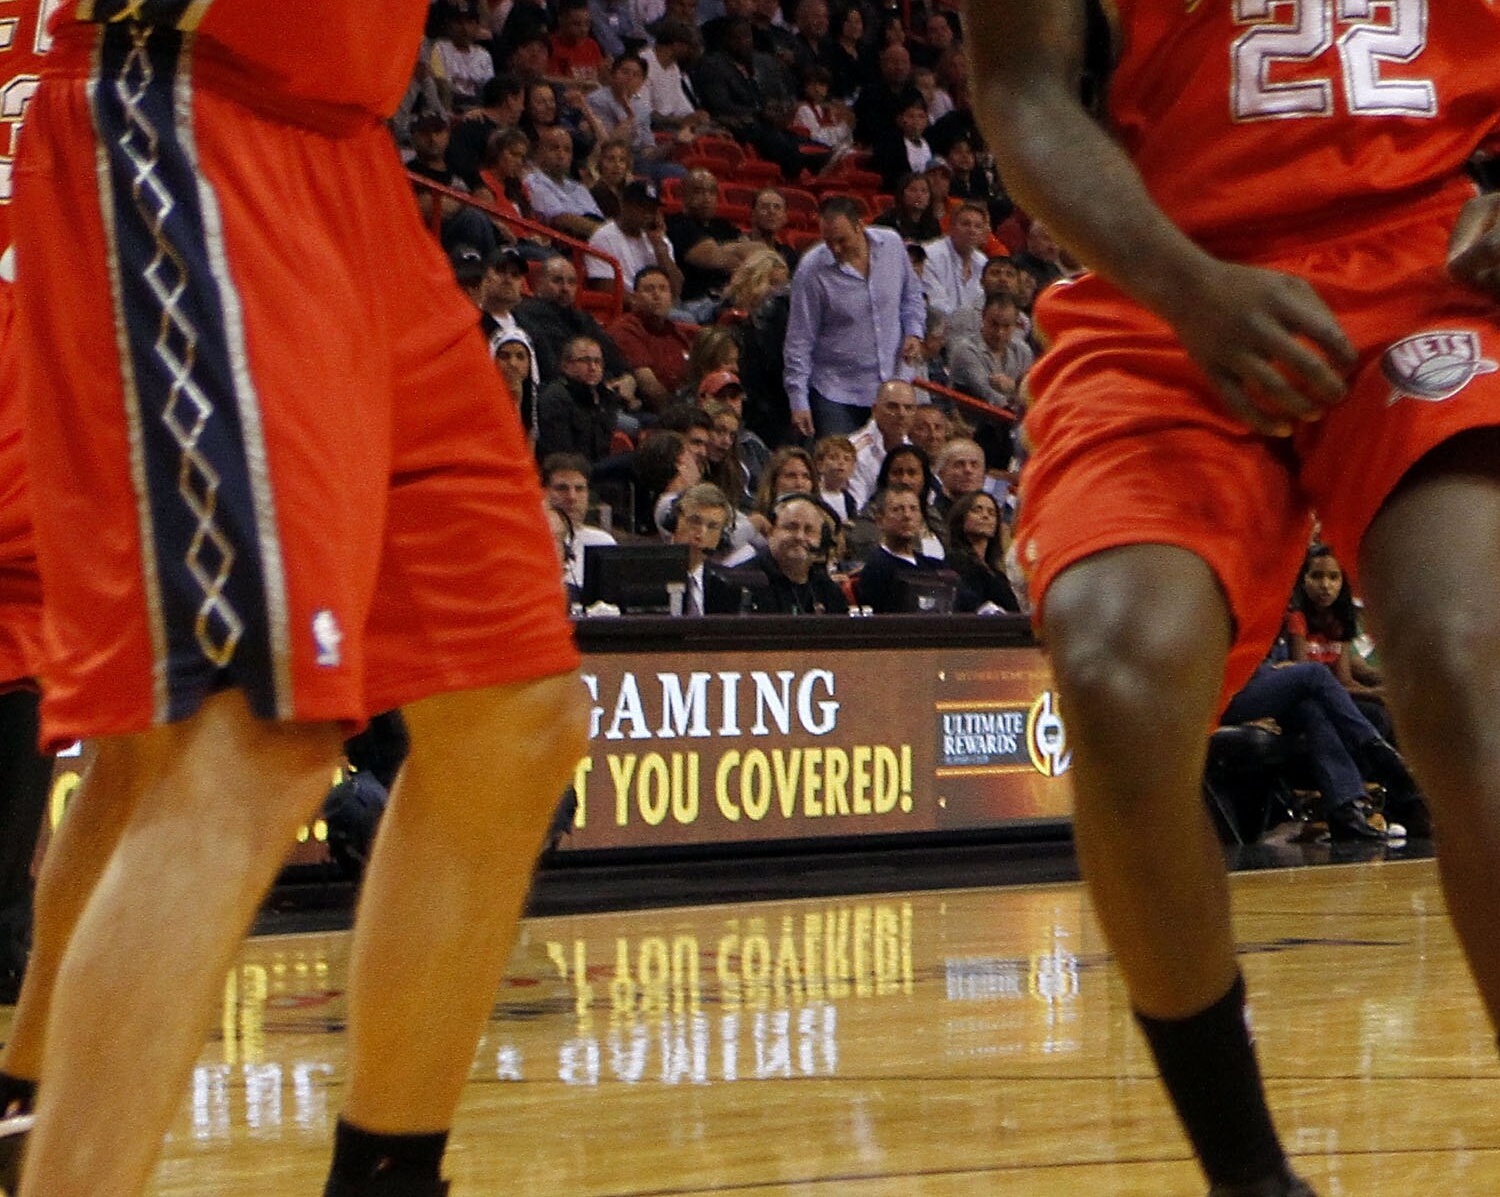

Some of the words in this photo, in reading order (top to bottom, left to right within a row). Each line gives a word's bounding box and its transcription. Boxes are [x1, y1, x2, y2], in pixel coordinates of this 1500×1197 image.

[1386, 333, 1475, 380] NETS
[943, 712, 1024, 736] ULTIMATE
[943, 733, 1019, 756] REWARDS
[606, 752, 700, 827] YOU
[715, 744, 914, 823] COVERED!
